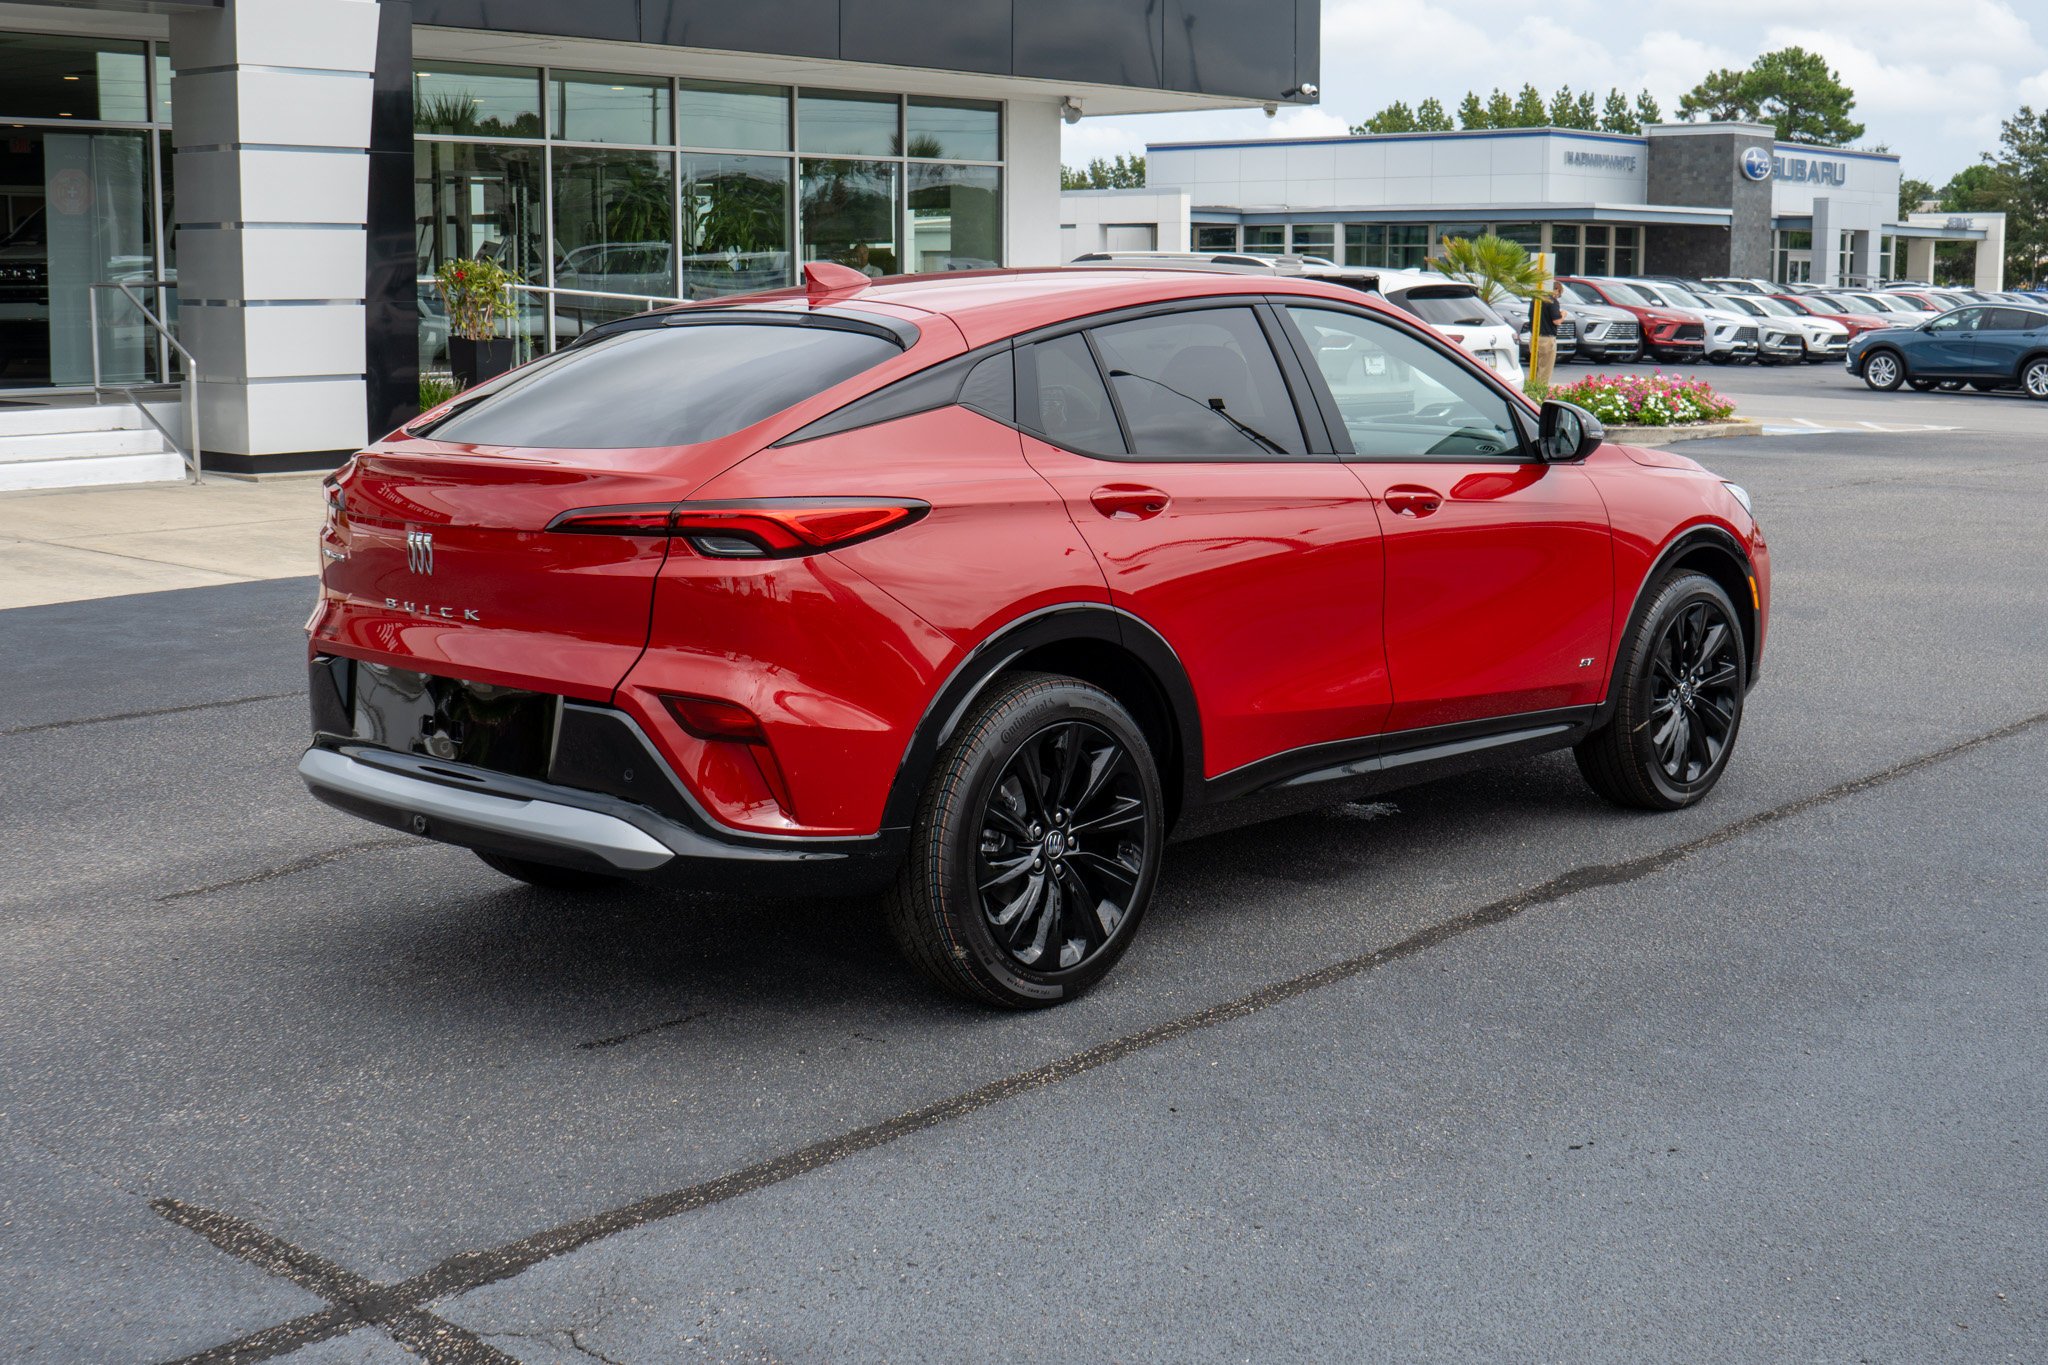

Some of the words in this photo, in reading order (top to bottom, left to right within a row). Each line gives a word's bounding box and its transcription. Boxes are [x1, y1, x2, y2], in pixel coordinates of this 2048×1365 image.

[1772, 156, 1845, 186] SUBARU
[385, 597, 480, 621] BUICK
[1001, 699, 1049, 744] Continental
